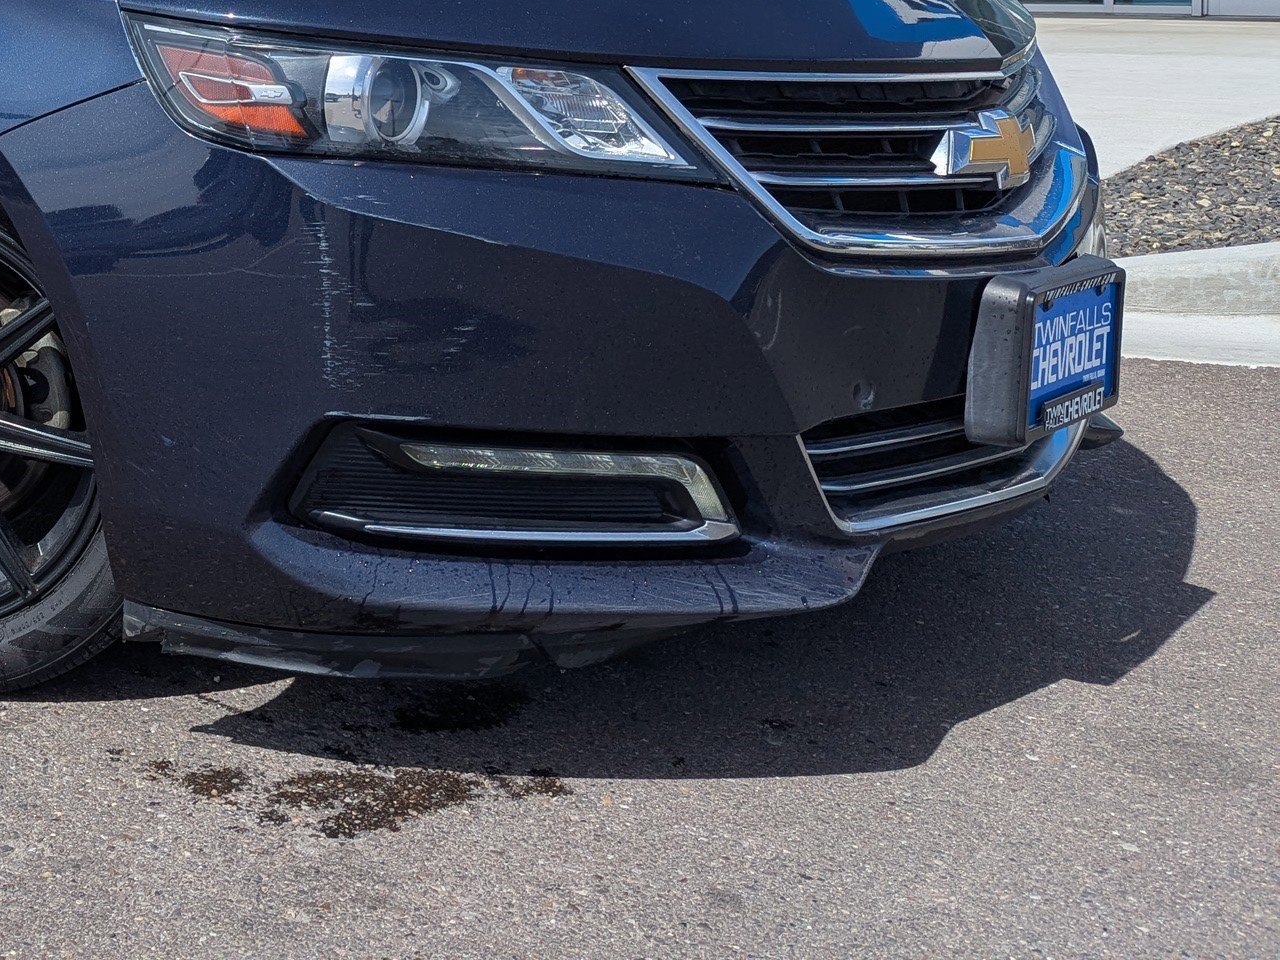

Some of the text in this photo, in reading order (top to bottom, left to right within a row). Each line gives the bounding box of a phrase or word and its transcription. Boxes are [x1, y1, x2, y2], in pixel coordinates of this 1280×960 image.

[1035, 302, 1111, 345] TWINFALLS
[1031, 326, 1110, 390] CHEVROLET
[1046, 402, 1064, 421] TWIN
[1064, 387, 1105, 423] CHEVROLET
